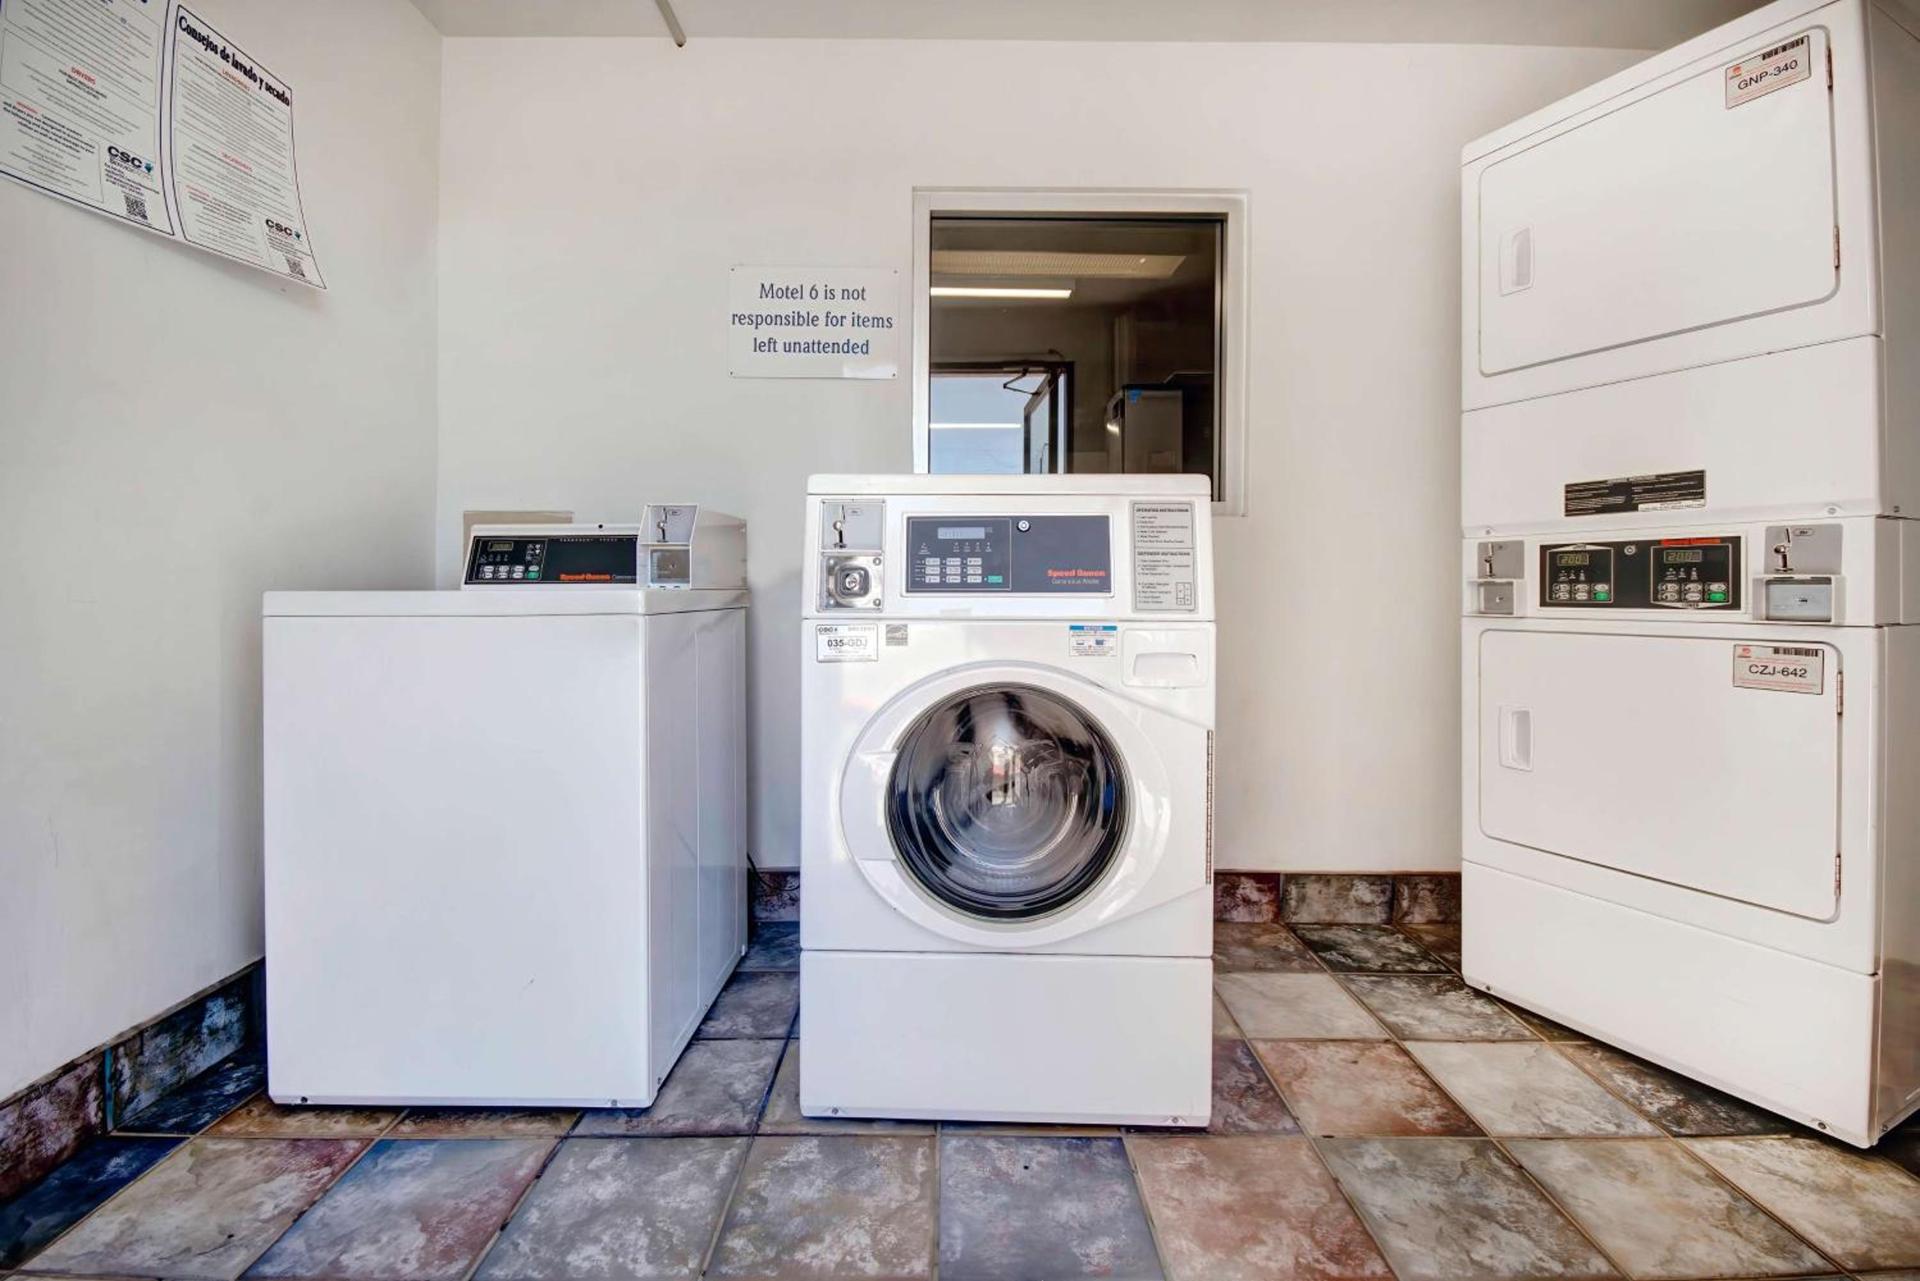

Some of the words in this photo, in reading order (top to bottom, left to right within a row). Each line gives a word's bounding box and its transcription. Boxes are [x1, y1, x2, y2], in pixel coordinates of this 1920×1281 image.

[179, 15, 218, 55] Consejos
[220, 45, 230, 63] de
[231, 52, 258, 83] lavado
[259, 76, 264, 91] y
[265, 81, 290, 107] secado
[1737, 59, 1799, 90] GNP-340
[107, 145, 143, 169] CSC
[265, 218, 293, 236] CSC
[759, 283, 804, 300] Motel
[809, 284, 819, 300] 6
[824, 284, 836, 300] is
[841, 286, 867, 301] not
[731, 311, 820, 330] responsible
[824, 311, 847, 327] for
[851, 312, 894, 329] items
[753, 337, 778, 352] left
[783, 339, 870, 355] unattended
[1748, 664, 1808, 679] CZJ-642
